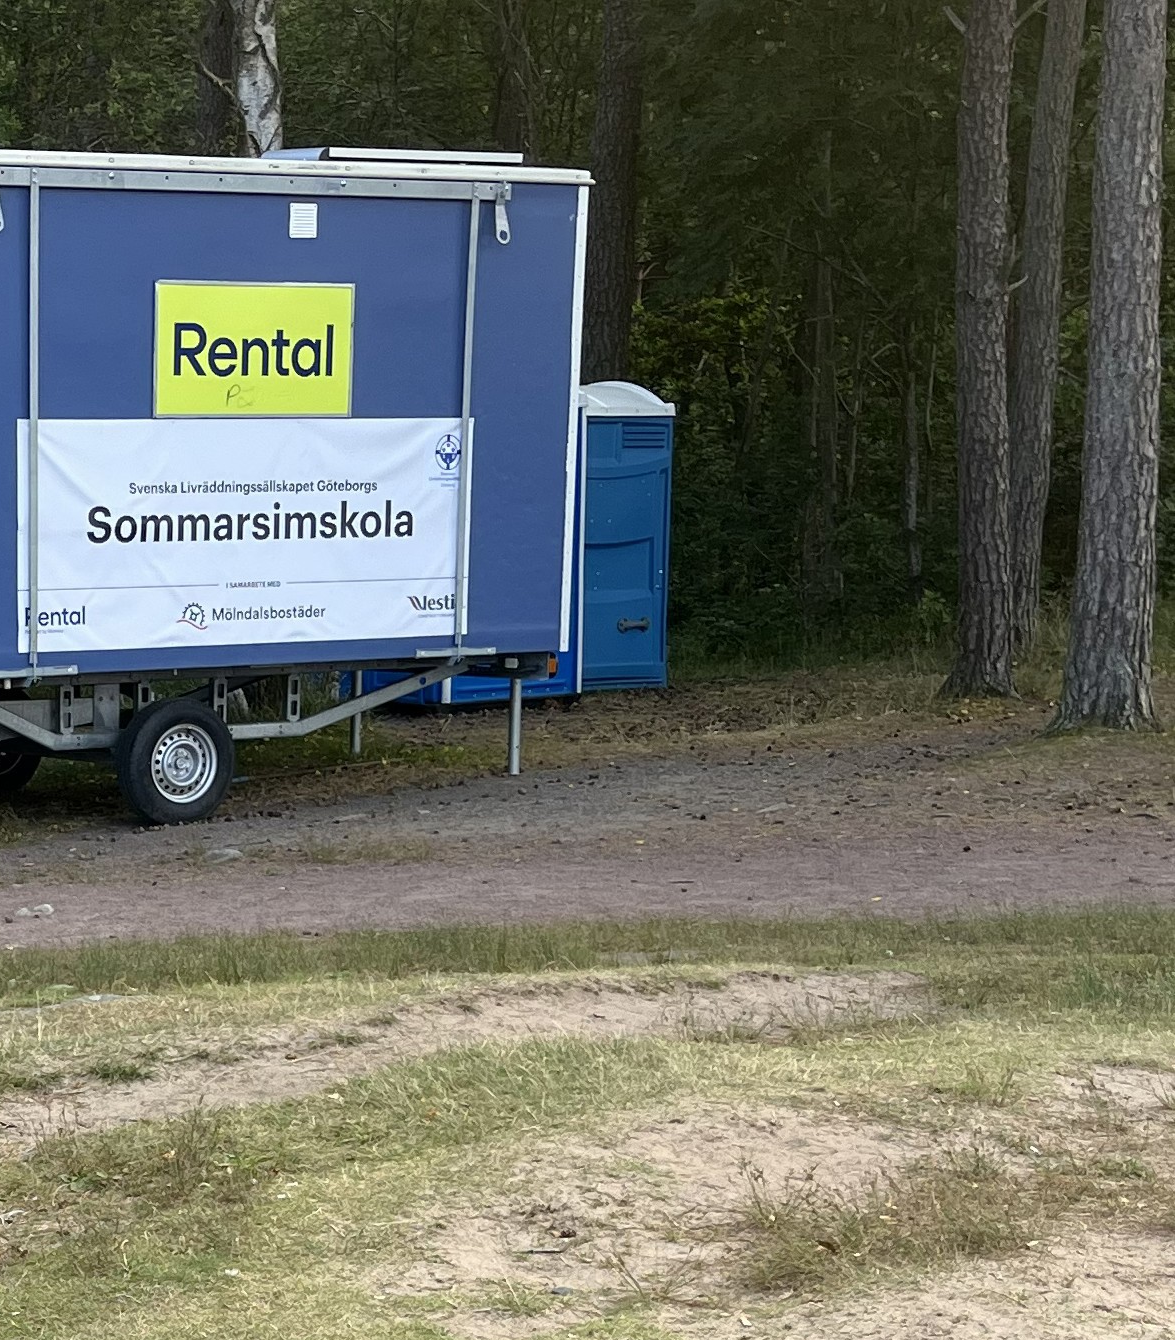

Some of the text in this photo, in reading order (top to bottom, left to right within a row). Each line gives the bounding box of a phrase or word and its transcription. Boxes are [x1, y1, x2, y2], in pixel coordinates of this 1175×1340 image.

[173, 322, 334, 377] Rental
[128, 479, 378, 495] Svenska Livräddningssällskapet Göteborgs
[87, 500, 414, 544] Sommarsimskola
[212, 605, 326, 621] Mölndalsbostäder
